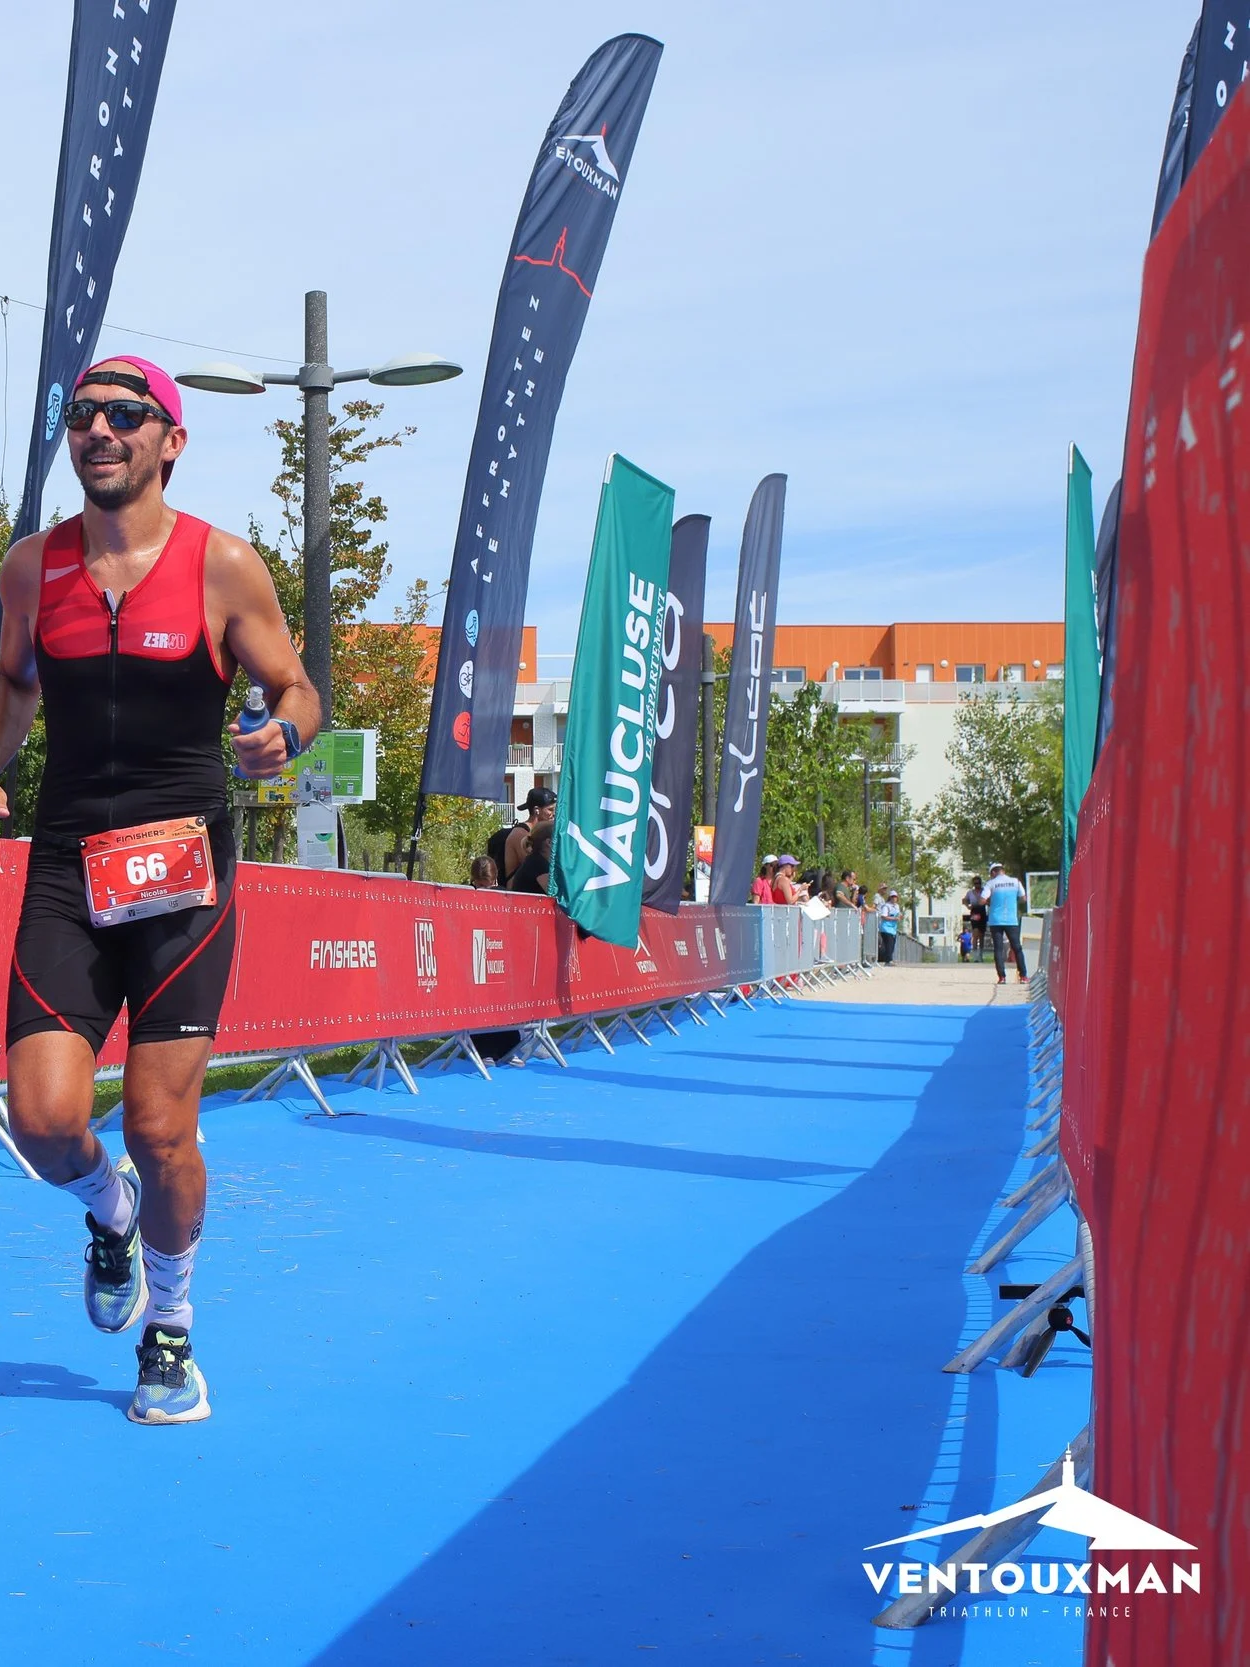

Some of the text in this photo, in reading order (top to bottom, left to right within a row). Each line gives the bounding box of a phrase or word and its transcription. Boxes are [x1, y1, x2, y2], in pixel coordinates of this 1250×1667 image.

[75, 0, 151, 345] LE MYTHE
[470, 294, 540, 575] AFFRONTEZ
[482, 348, 545, 584] LE MYTHE
[566, 572, 655, 892] VAUCLUSE
[646, 587, 665, 734] DÉPARTEMENT
[126, 852, 168, 885] 66
[140, 888, 168, 899] Nicolas
[310, 940, 377, 969] FINISHERS
[415, 922, 437, 977] LFCC
